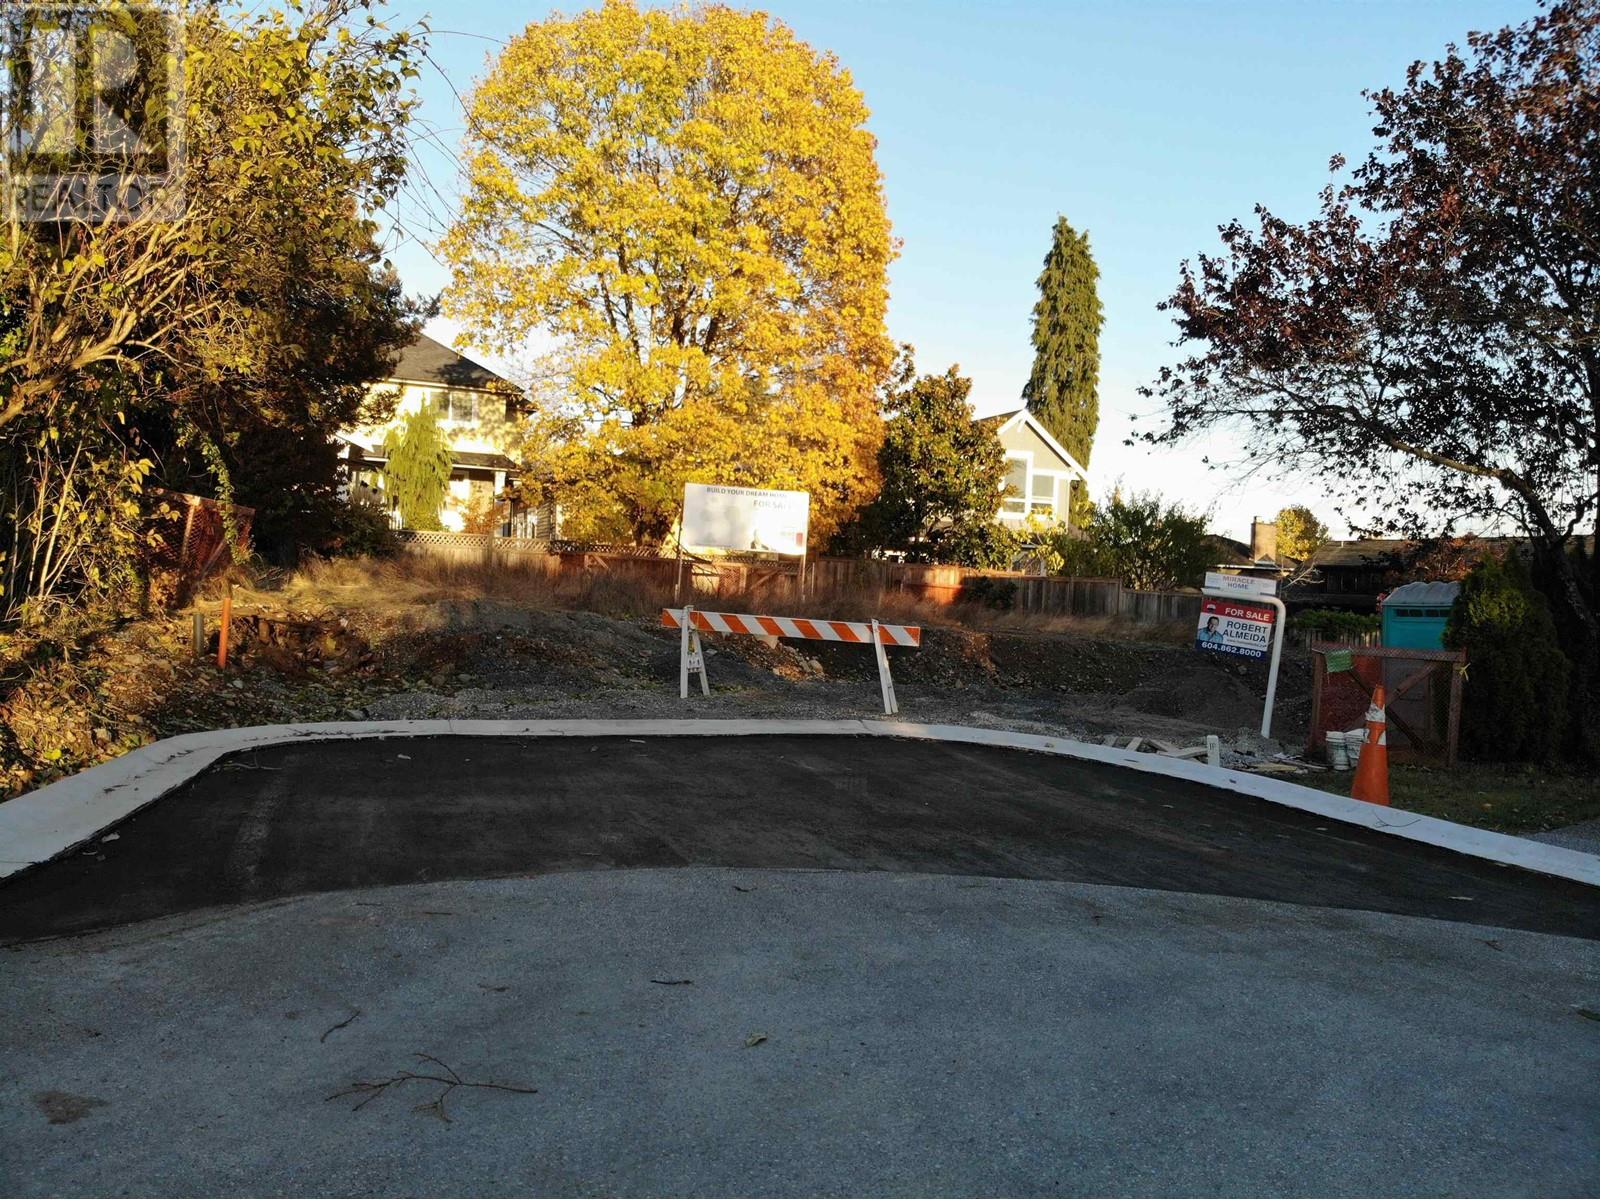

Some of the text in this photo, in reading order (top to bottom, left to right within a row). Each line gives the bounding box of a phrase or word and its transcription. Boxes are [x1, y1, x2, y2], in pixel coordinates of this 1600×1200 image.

[707, 487, 726, 495] BUILD
[727, 488, 745, 496] YOUR
[745, 489, 769, 497] DREAM
[1222, 575, 1255, 585] MIRACLE
[1227, 582, 1249, 590] HOME
[1224, 607, 1270, 621] FOR SALE
[1226, 620, 1268, 634] ROBERT
[1222, 629, 1267, 643] ALMEIDA
[1201, 641, 1262, 658] 604.862.8000
